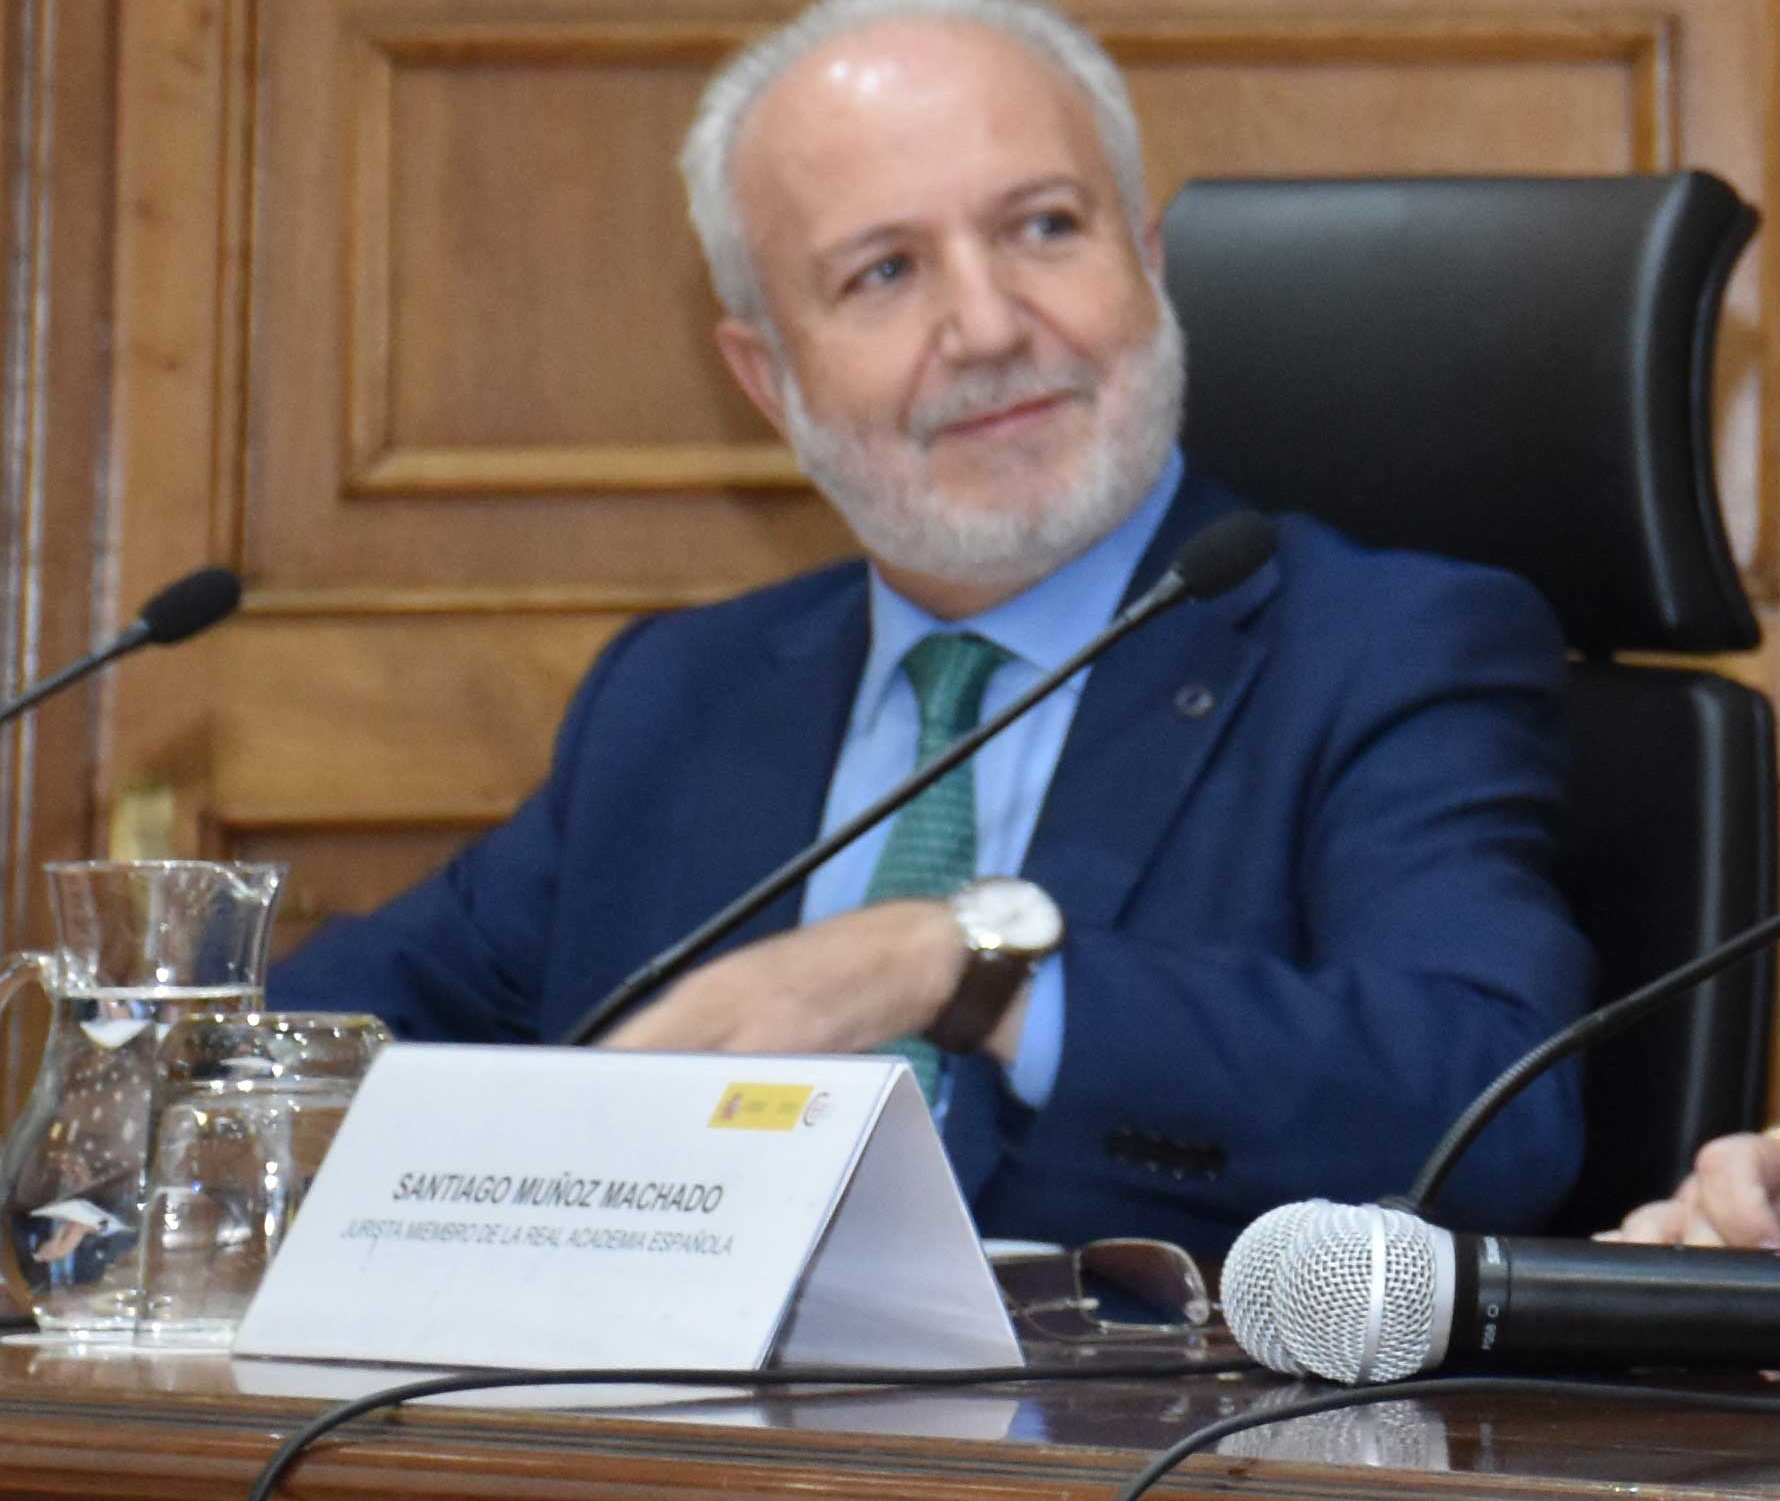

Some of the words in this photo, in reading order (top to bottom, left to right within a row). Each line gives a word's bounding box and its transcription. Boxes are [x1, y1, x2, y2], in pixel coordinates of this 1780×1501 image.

[393, 1172, 512, 1204] SANTIAGO
[511, 1171, 600, 1208] MUÑOZ
[600, 1180, 724, 1214] MACHADO
[341, 1218, 404, 1241] JURISTA
[405, 1221, 477, 1242] MIEMBRO
[473, 1224, 501, 1244] DE
[500, 1225, 524, 1245] LA
[526, 1226, 562, 1248] REAL
[567, 1227, 647, 1251] ACADEMIA
[647, 1229, 734, 1256] ESPAÑOLA
